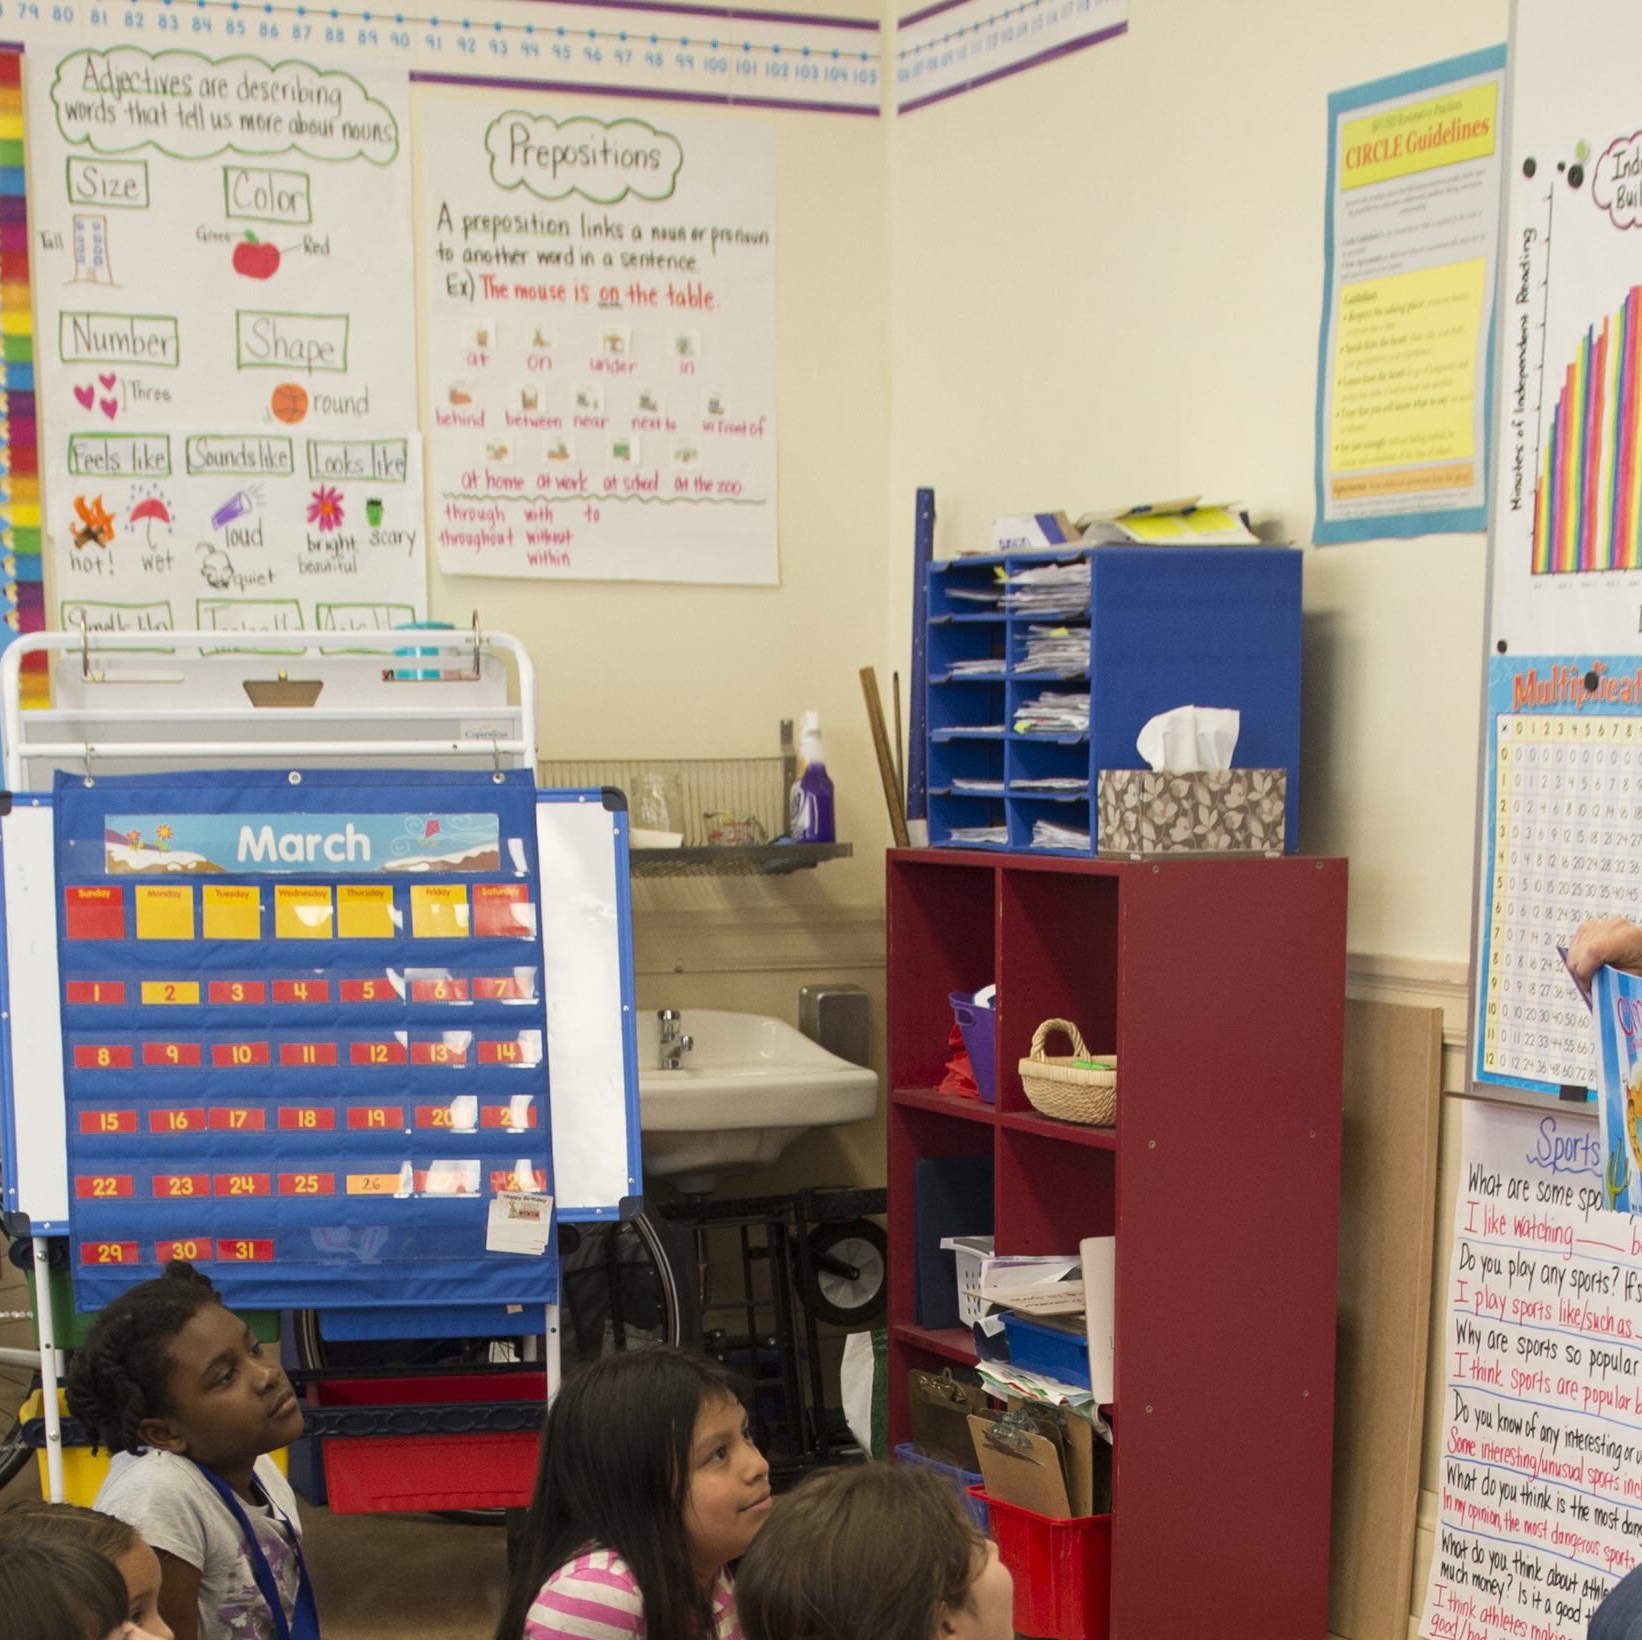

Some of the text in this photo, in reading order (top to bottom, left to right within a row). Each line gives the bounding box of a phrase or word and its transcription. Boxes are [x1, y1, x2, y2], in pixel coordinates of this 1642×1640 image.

[81, 56, 344, 118] Adjectives are describing
[509, 122, 661, 178] Prepositions
[1345, 135, 1403, 171] CIRCLE
[1405, 117, 1490, 154] Guidelines
[77, 167, 139, 201] Size
[234, 174, 304, 214] Color
[479, 274, 509, 300] The
[514, 284, 566, 301] mouse
[574, 284, 589, 301] is
[600, 286, 621, 305] on
[627, 286, 656, 305] the
[73, 318, 173, 356] Number
[246, 317, 335, 376] Shape
[313, 387, 369, 414] round
[238, 823, 371, 863] March
[148, 888, 182, 901] Monday
[215, 888, 250, 901] Tuesday
[278, 888, 327, 900] Wednesday
[347, 887, 385, 900] Thursday
[426, 886, 451, 898] Friday
[232, 1047, 252, 1063] 10
[302, 1046, 315, 1063] 11
[100, 1113, 119, 1131] 15
[229, 1110, 248, 1127] 17
[298, 1110, 317, 1128] 18
[1535, 1117, 1601, 1174] Sports
[93, 1179, 117, 1196] 22
[229, 1177, 255, 1194] 24
[295, 1176, 318, 1192] 25
[1464, 1202, 1478, 1233] I
[1484, 1207, 1508, 1233] like
[1513, 1215, 1574, 1260] watching
[172, 1243, 197, 1260] 30
[236, 1243, 254, 1260] 31
